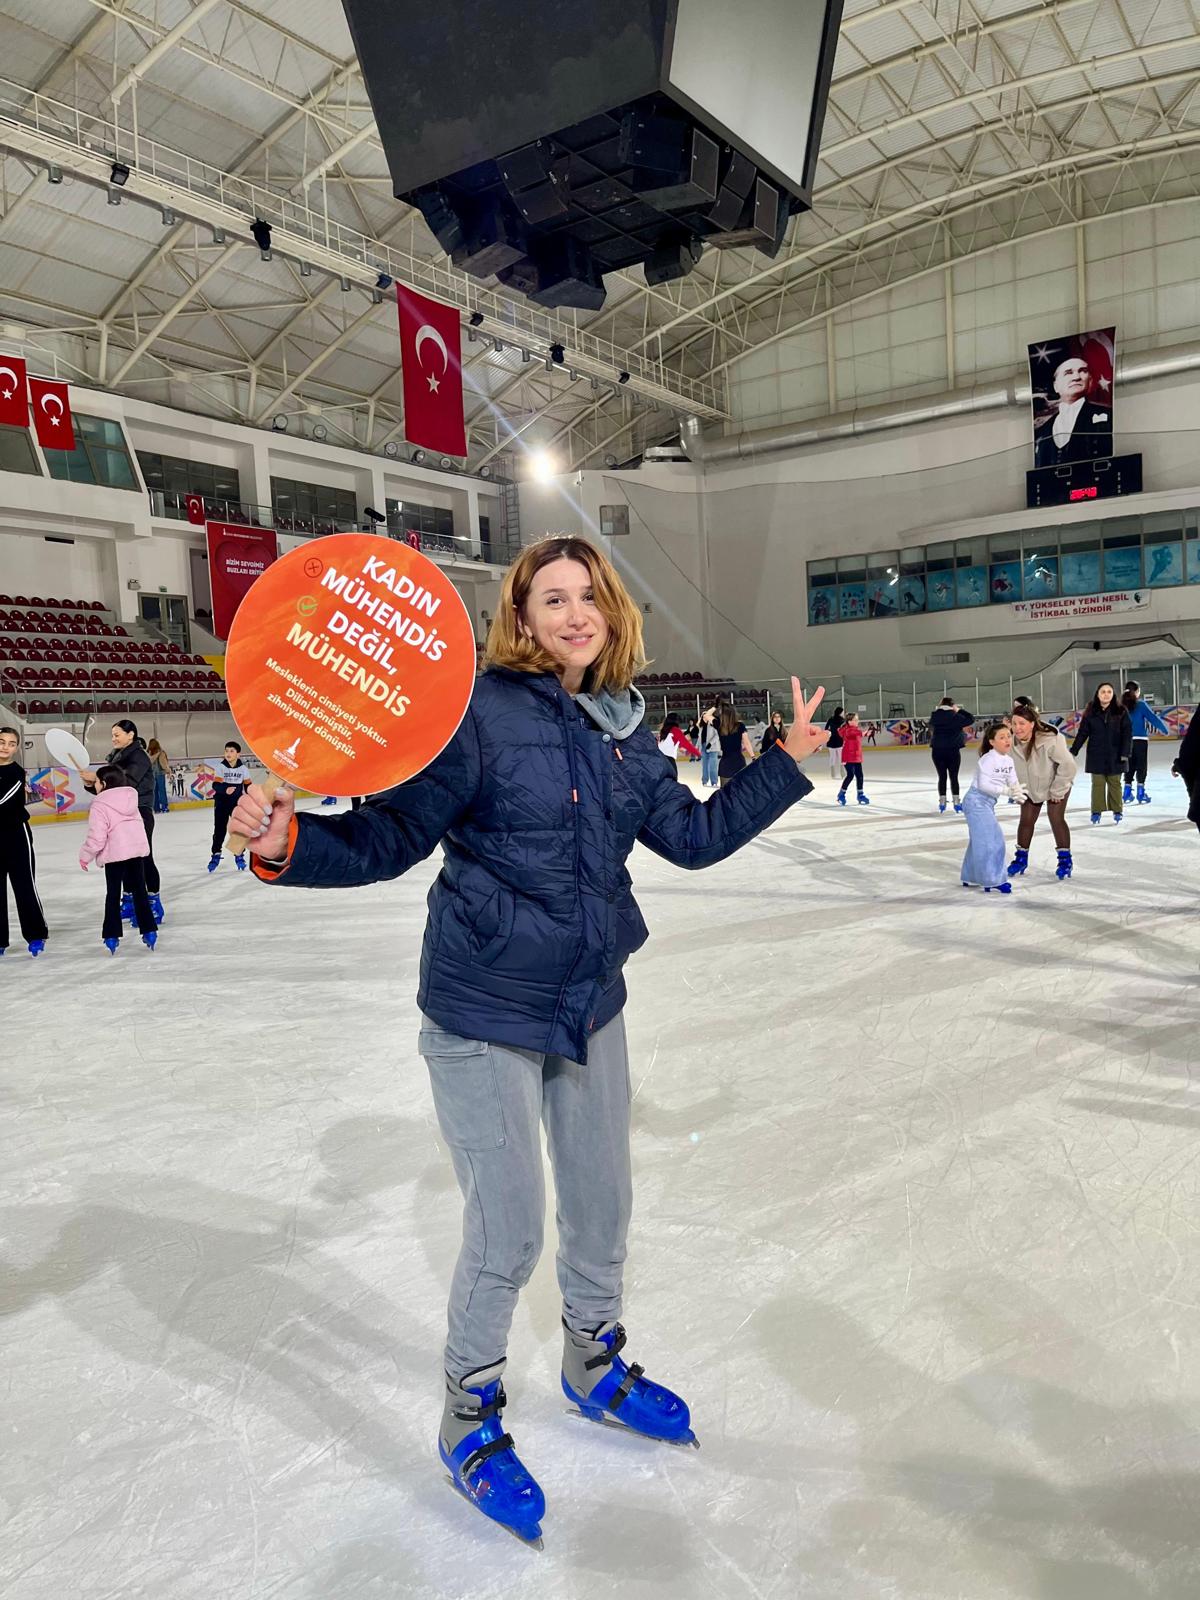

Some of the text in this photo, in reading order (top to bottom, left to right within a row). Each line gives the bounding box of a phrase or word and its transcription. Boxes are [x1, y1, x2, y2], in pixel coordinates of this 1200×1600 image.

[320, 567, 448, 661] MÜHENDİS
[362, 555, 441, 618] KADIN
[1029, 599, 1076, 610] YÜKSELEN
[1077, 595, 1100, 606] YENİ
[1102, 592, 1130, 603] NESİL
[1030, 604, 1112, 619] İSTİKBAL SİZİNDİR
[285, 622, 411, 717] MÜHENDİS
[326, 610, 398, 676] DEĞİL,
[265, 657, 388, 748] Mesleklerin cinsiyeti yoktur.
[266, 692, 356, 759] zihniyetini dönüştür.
[285, 687, 353, 741] Dilini dönüştür,
